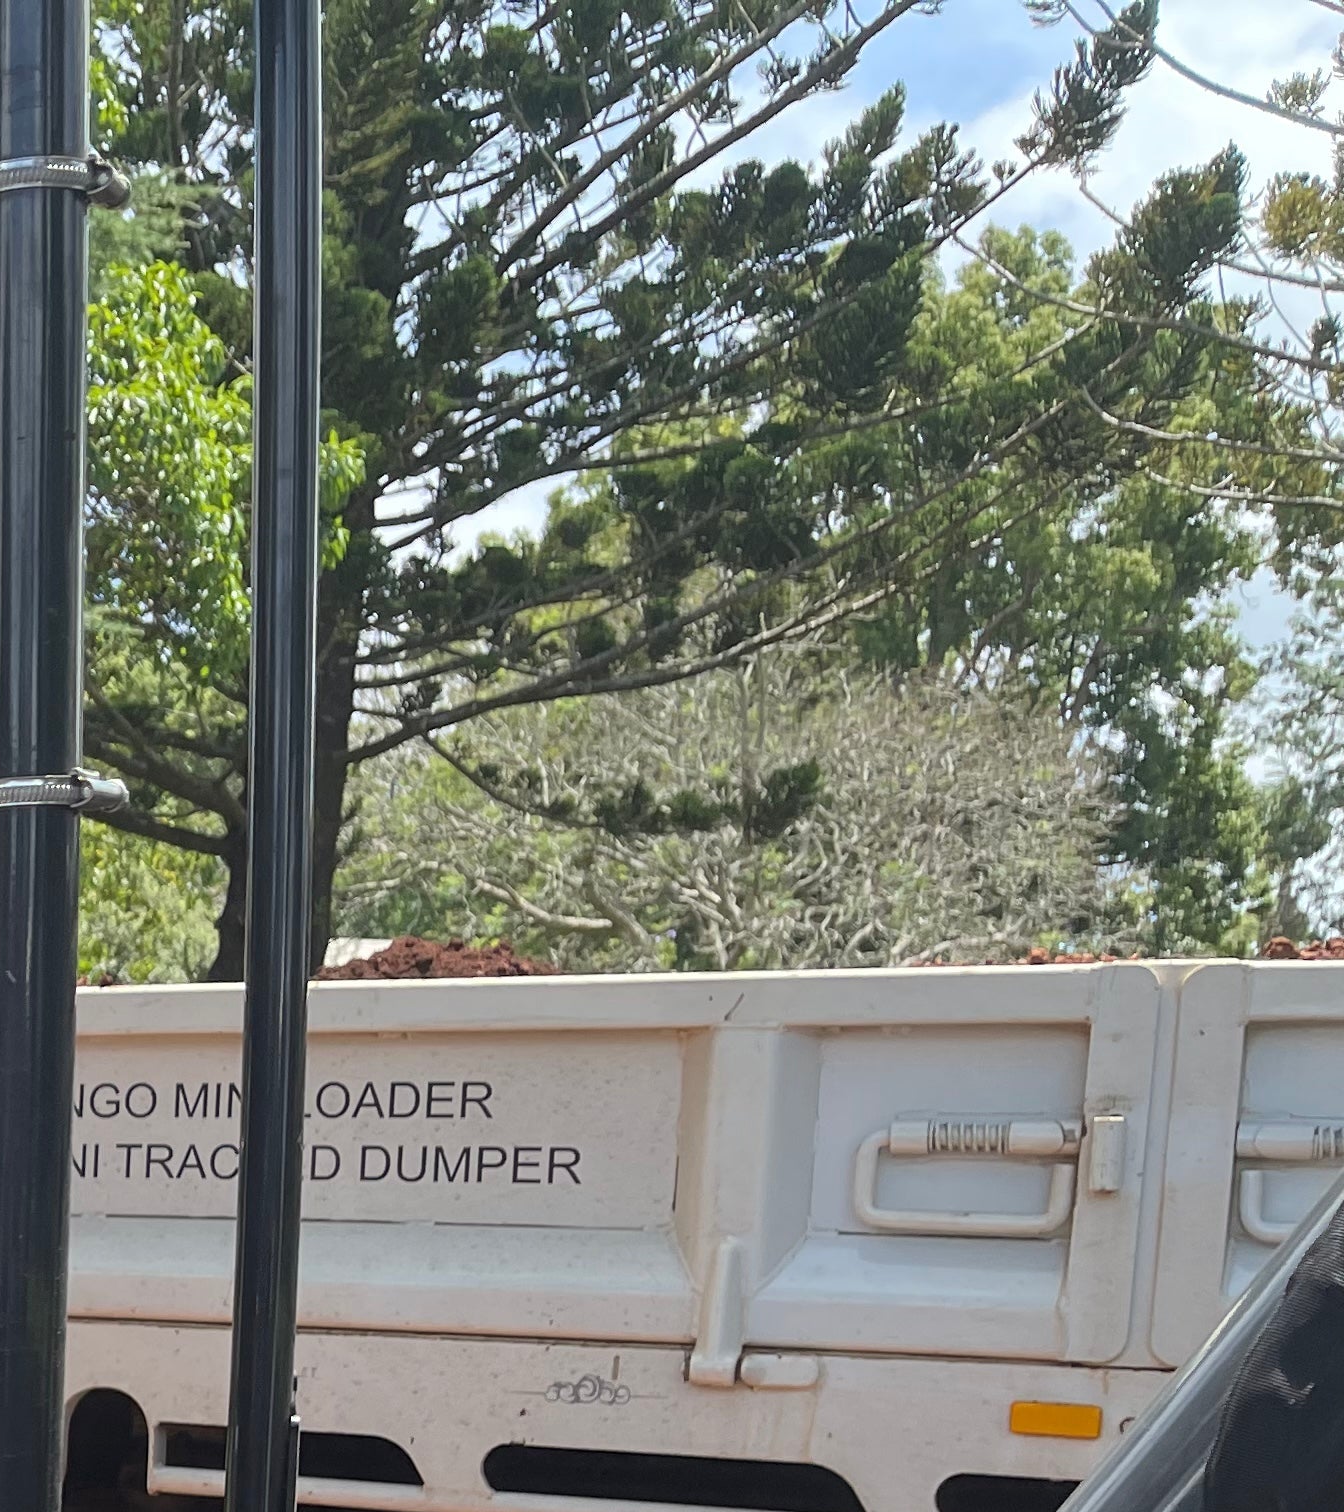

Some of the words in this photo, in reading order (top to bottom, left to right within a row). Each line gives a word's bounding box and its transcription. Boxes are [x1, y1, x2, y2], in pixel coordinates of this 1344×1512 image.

[304, 1081, 495, 1119] OADER
[115, 1143, 341, 1181] TRACD
[359, 1144, 582, 1185] DUMPER
